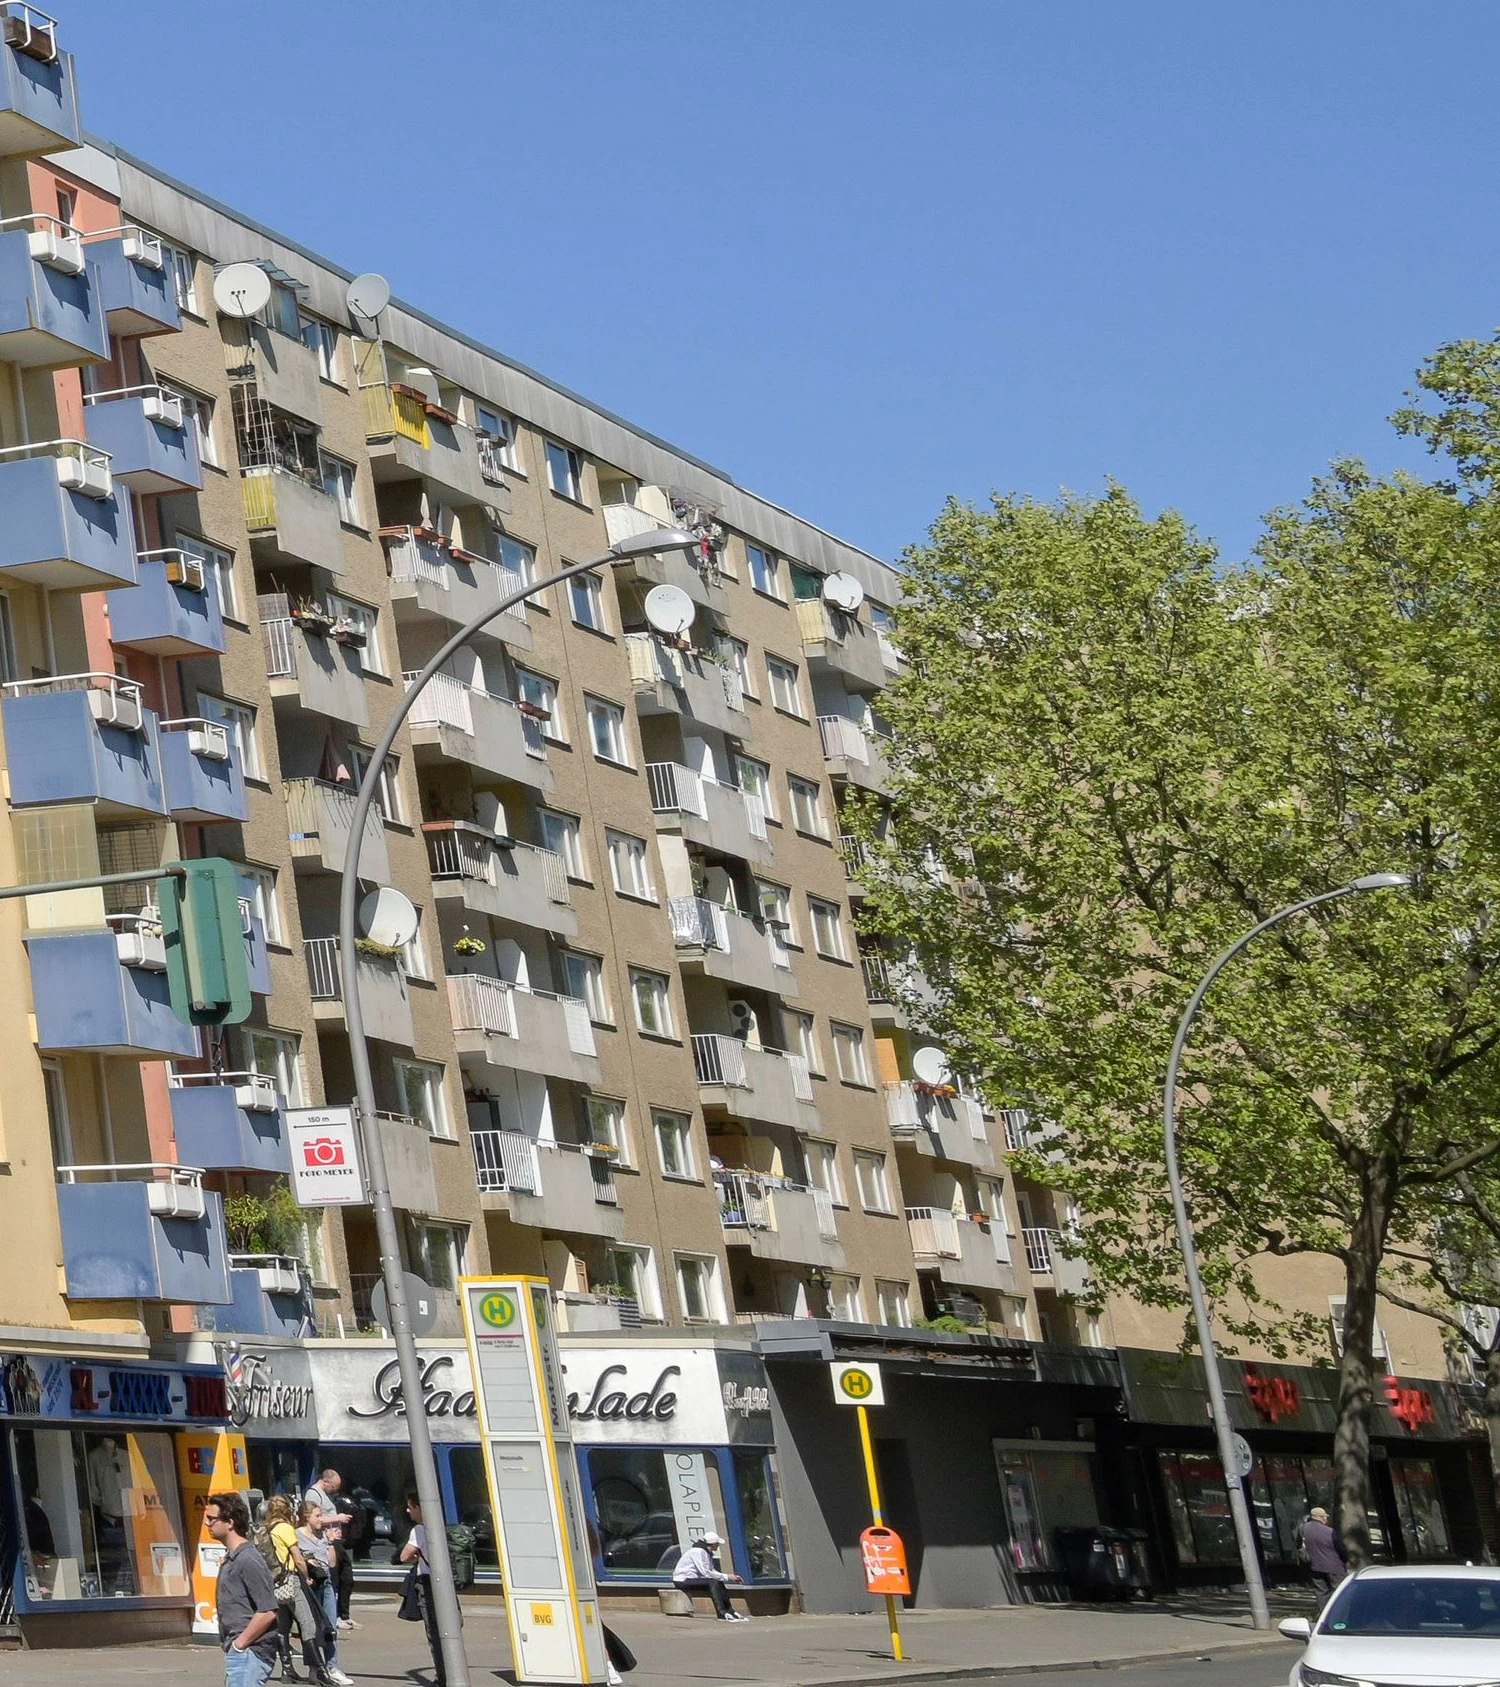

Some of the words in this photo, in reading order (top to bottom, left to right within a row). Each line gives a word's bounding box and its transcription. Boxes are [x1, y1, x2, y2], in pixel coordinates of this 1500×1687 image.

[300, 1170, 322, 1178] FOTO
[323, 1168, 354, 1177] MEYER
[231, 1355, 314, 1427] Friseur
[675, 1453, 707, 1544] OLAPLE
[534, 1614, 552, 1624] BVG
